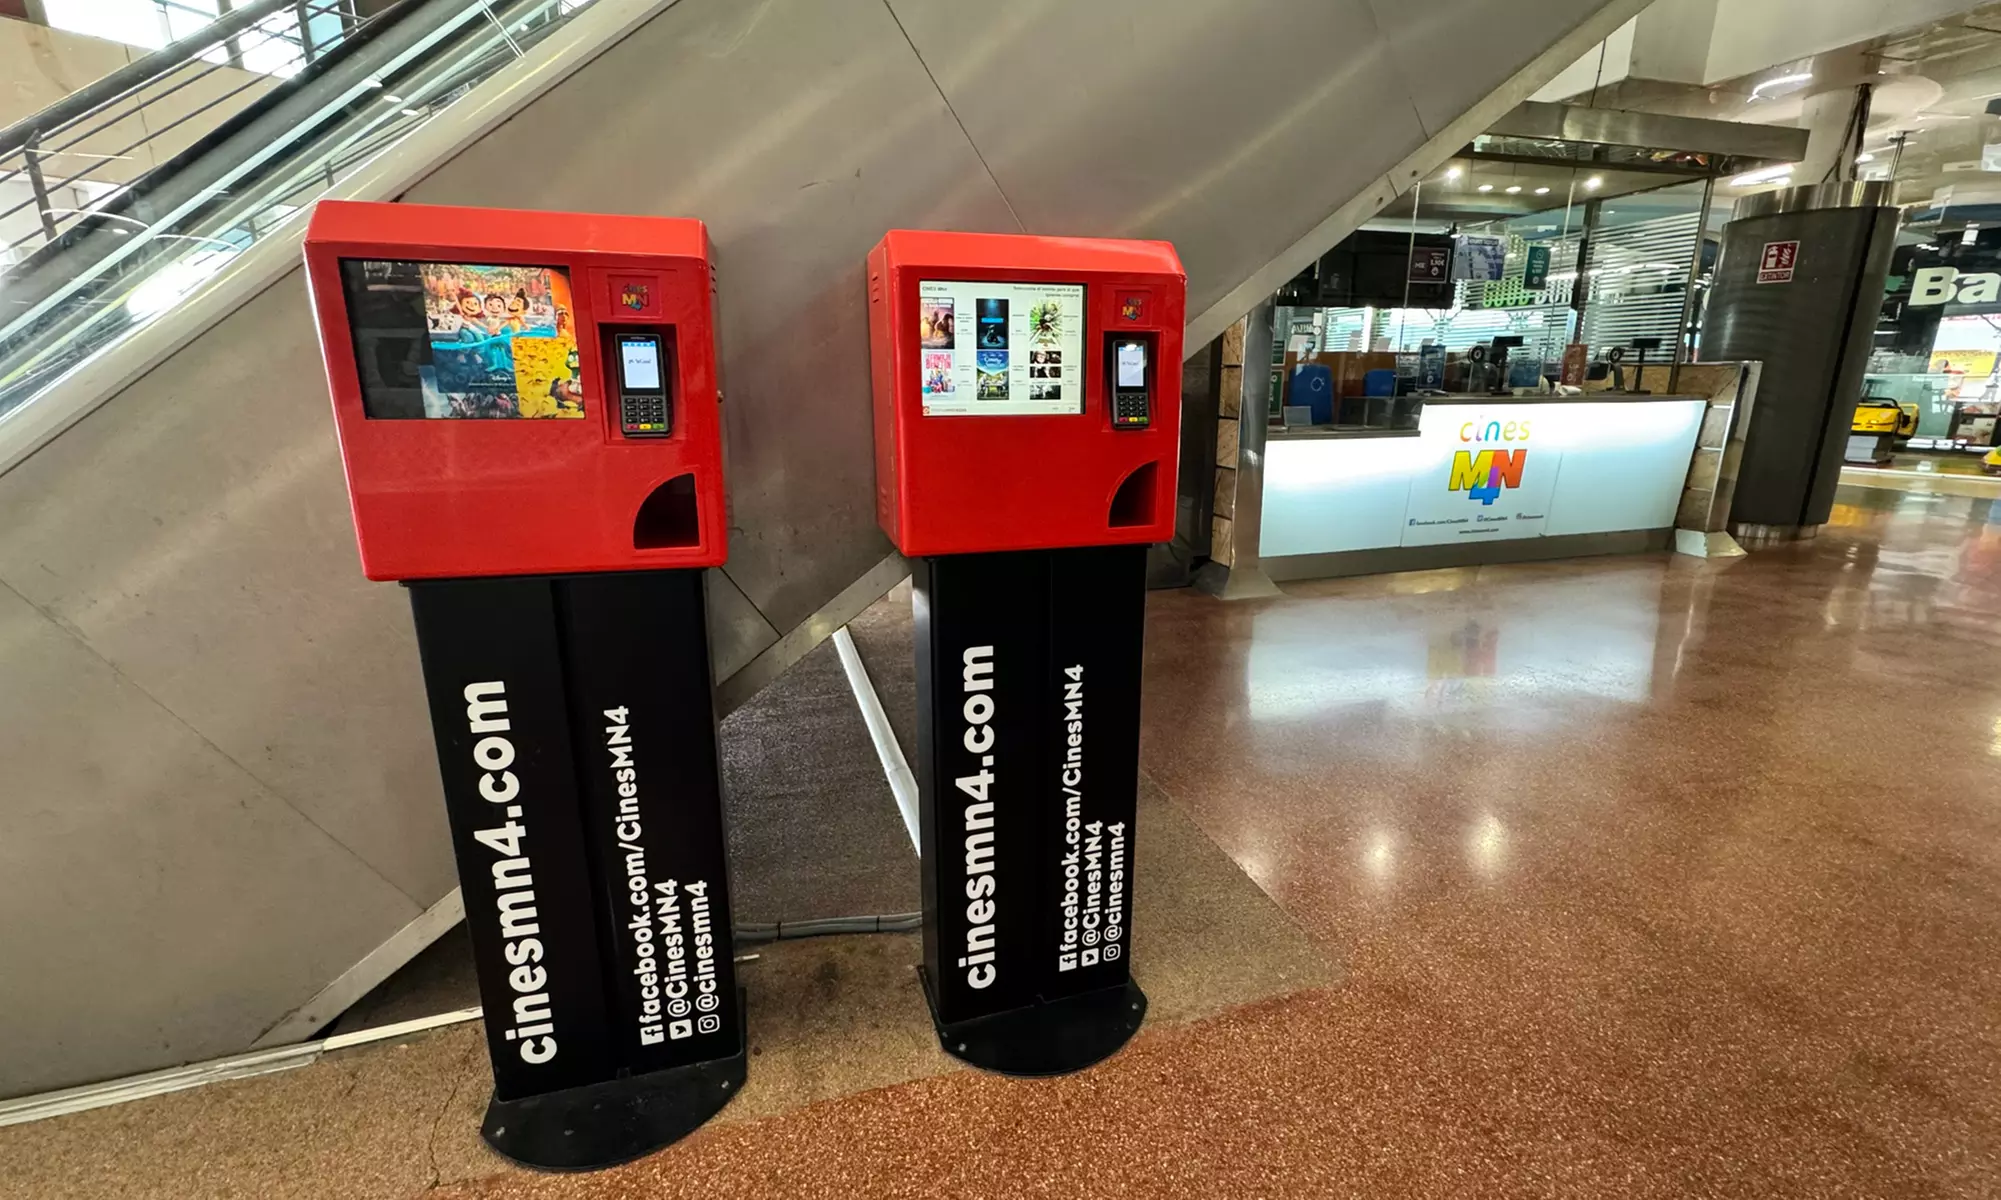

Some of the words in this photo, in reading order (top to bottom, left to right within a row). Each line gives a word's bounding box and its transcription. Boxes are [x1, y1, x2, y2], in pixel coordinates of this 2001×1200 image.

[1760, 272, 1790, 281] EXTINTOR
[1908, 267, 2000, 306] Ba
[1460, 415, 1532, 442] cines
[464, 680, 557, 1064] cinesmn4.com
[603, 705, 664, 1034] facebook.com/CinesMN4
[955, 644, 997, 990] cinesmn4.com
[1060, 664, 1084, 954] facebook.com/CinesMN4
[654, 878, 692, 1018] @CinesMN4
[684, 880, 720, 1012] @cinesmn4
[1081, 820, 1103, 947] @CinesMN4
[1104, 821, 1126, 943] @cinesmn4
